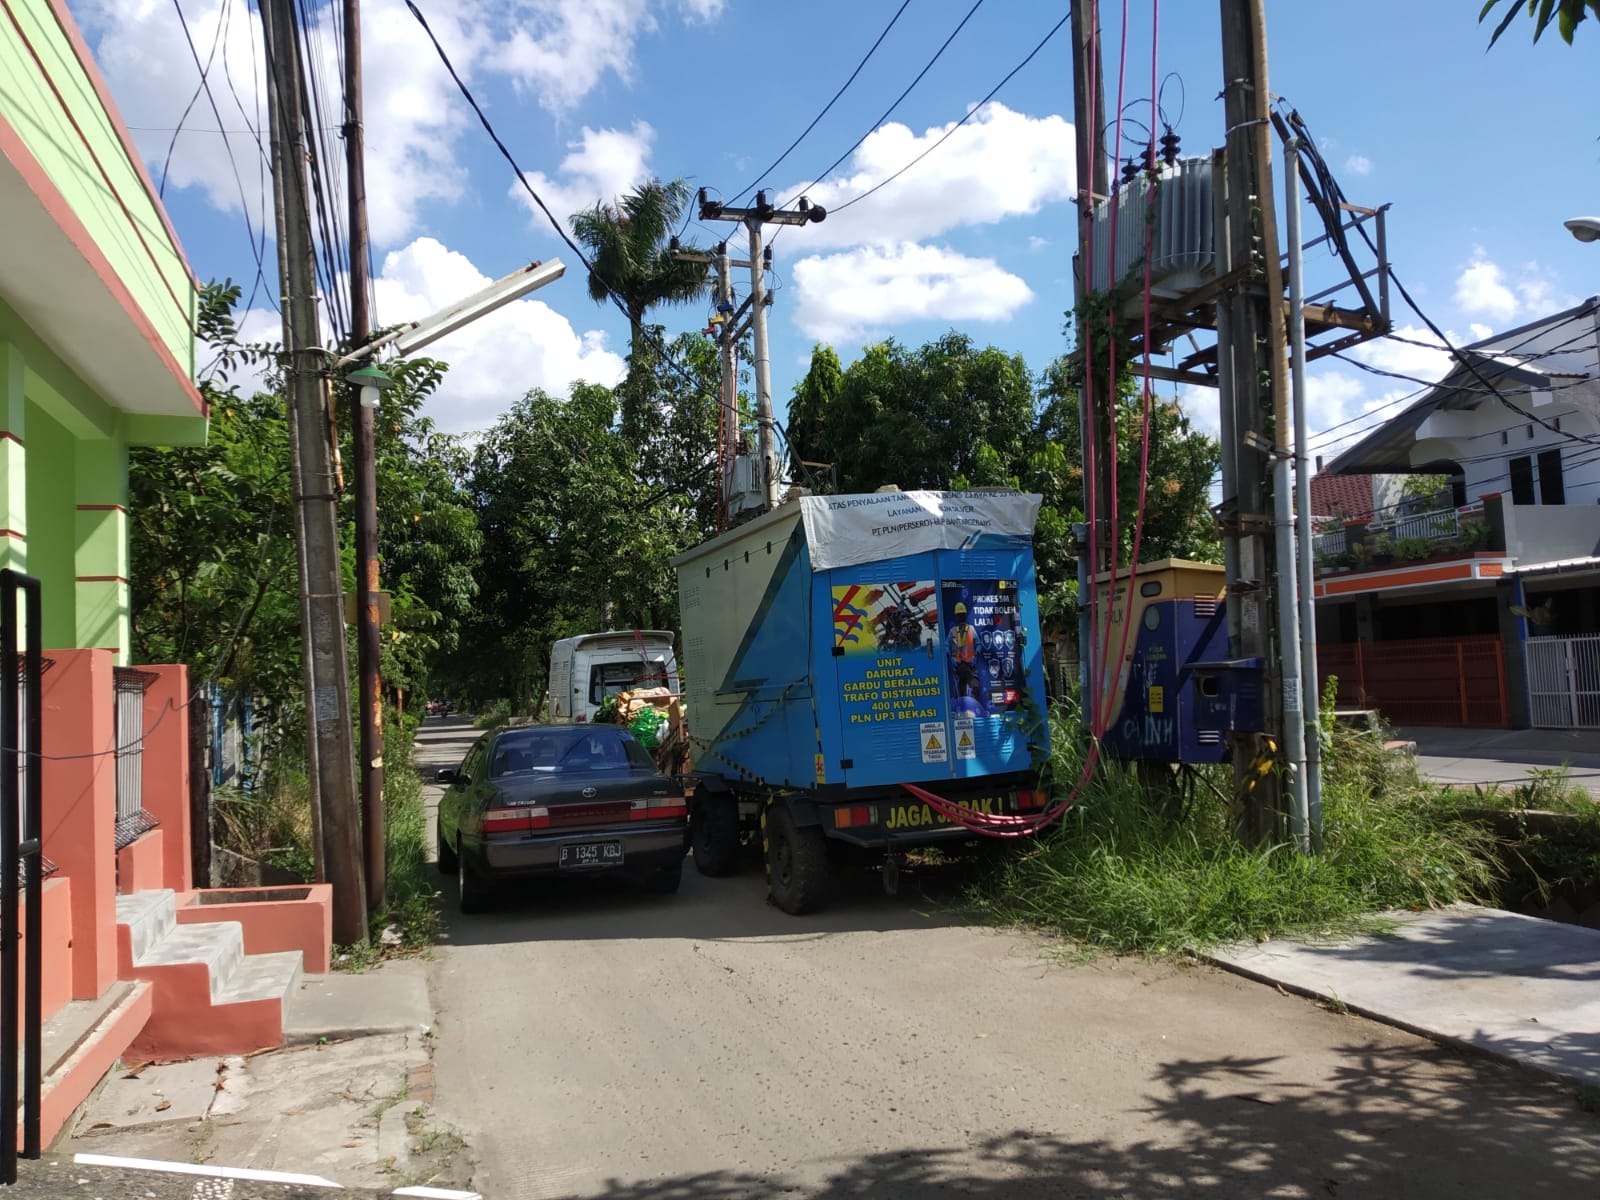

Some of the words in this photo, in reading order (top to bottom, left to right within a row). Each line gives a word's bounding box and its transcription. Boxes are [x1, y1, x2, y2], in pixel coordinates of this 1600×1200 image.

[973, 606, 994, 615] TIDAK
[876, 657, 902, 668] UNIT
[866, 667, 915, 679] DARURAT
[843, 681, 880, 692] GARDU
[884, 676, 939, 689] BERJALAN
[843, 692, 879, 702] TRAFO
[881, 687, 941, 700] DISTRIBUSI
[871, 702, 890, 711] 400
[893, 700, 915, 709] KVA
[850, 713, 872, 724] PLN
[874, 712, 895, 722] UP3
[898, 708, 937, 720] BEKASI
[885, 804, 933, 828] JAGA
[561, 847, 569, 861] B
[575, 845, 598, 860] 1345
[603, 841, 622, 858] KBJ
